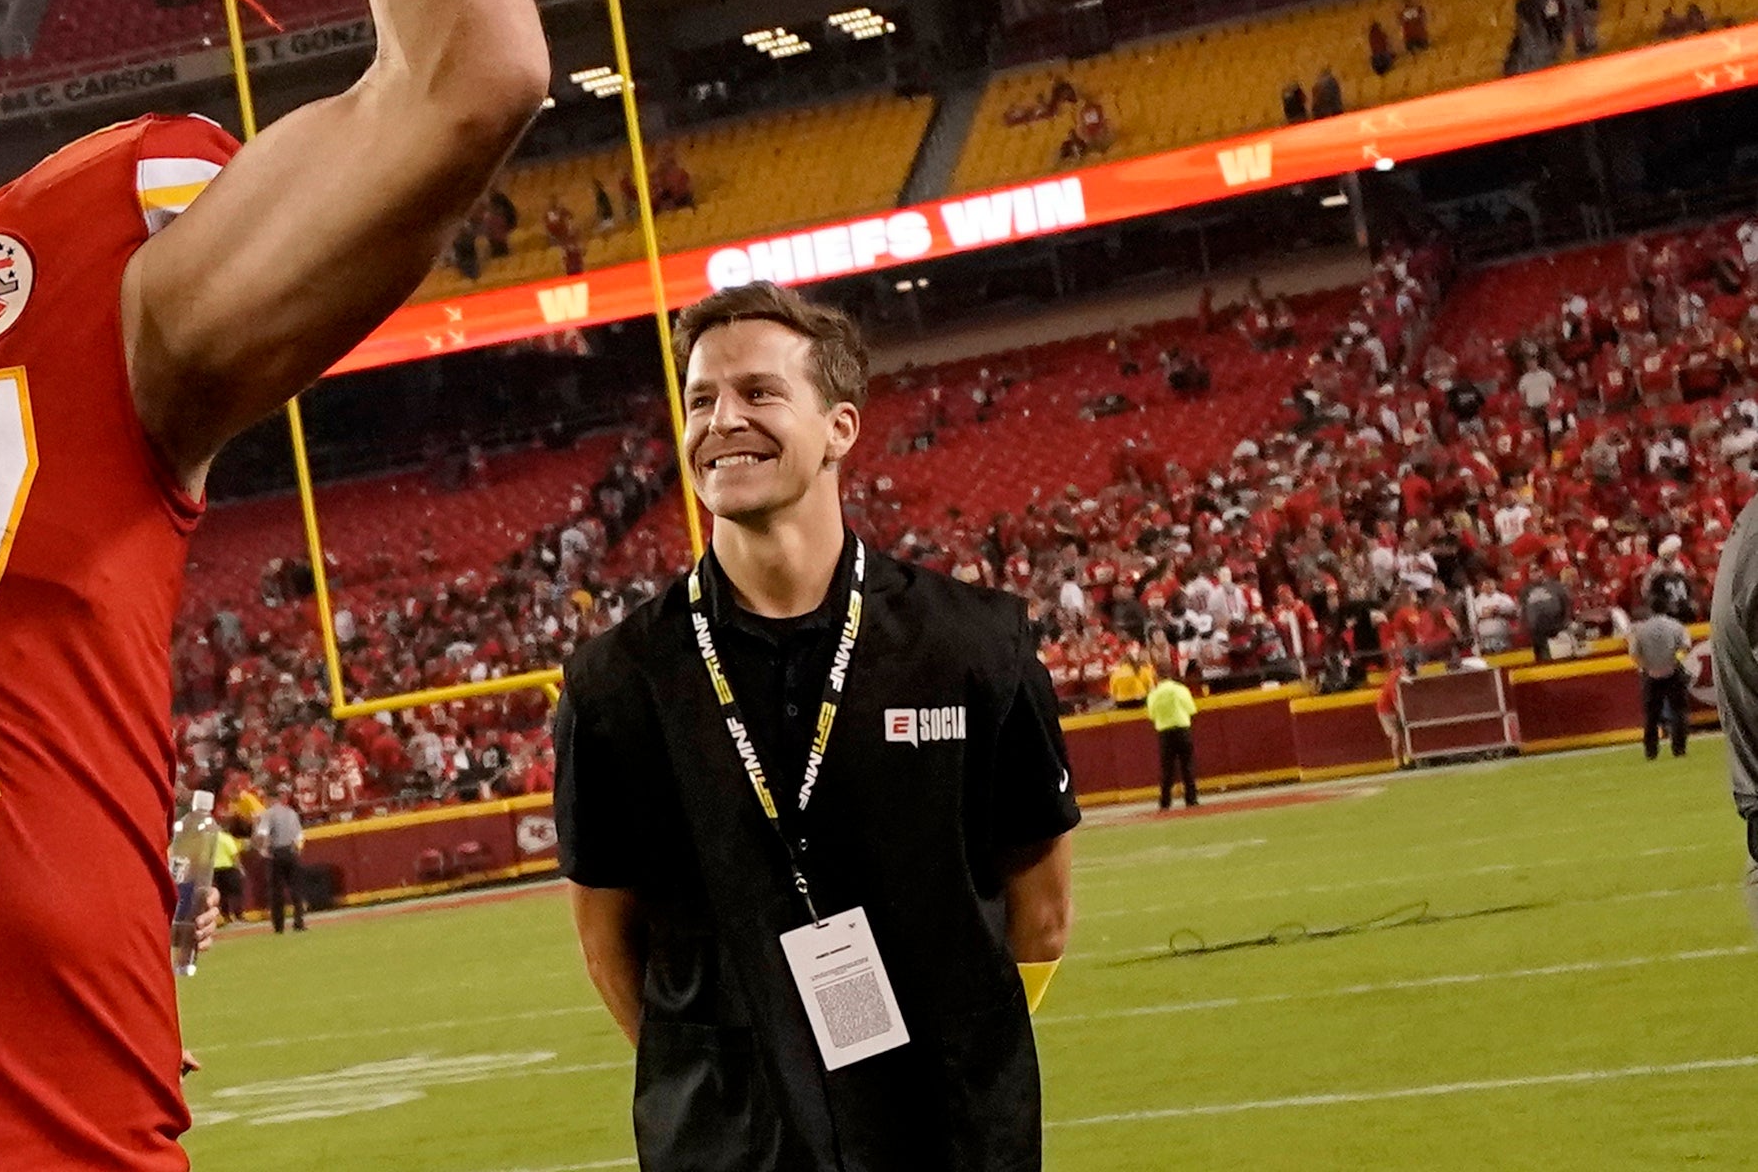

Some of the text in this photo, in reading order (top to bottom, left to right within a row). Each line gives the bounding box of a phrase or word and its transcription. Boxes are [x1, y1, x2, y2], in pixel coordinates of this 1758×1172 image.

[1216, 141, 1272, 186] W
[707, 175, 1086, 291] CHIEFS WIN
[536, 282, 590, 325] W
[692, 611, 717, 661] MNF
[829, 635, 855, 693] MNF
[726, 716, 761, 773] MNF
[798, 751, 823, 811] MNF
